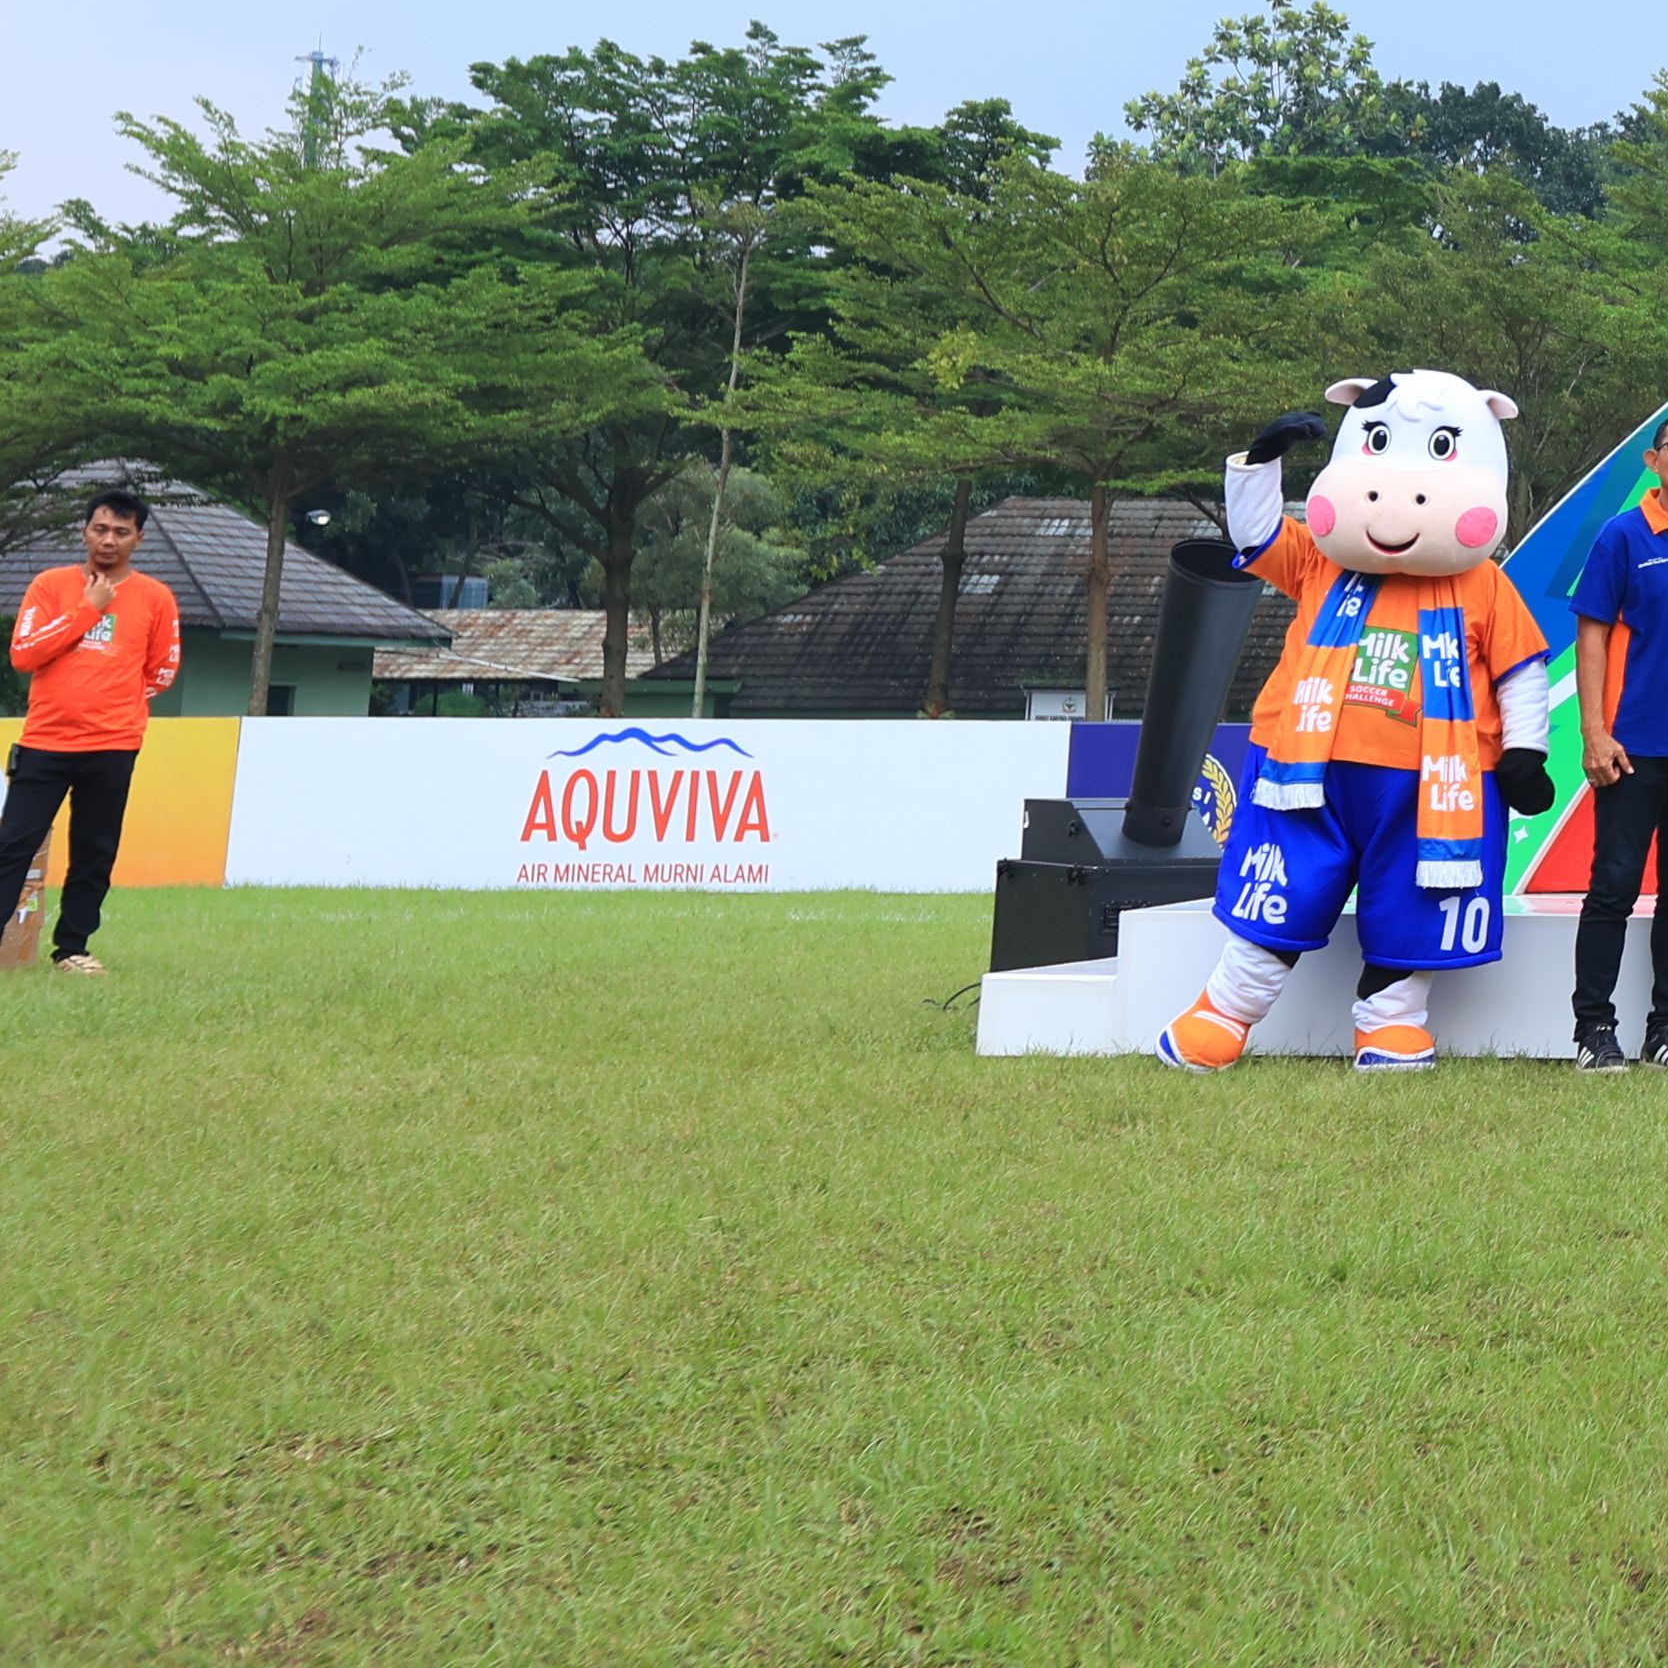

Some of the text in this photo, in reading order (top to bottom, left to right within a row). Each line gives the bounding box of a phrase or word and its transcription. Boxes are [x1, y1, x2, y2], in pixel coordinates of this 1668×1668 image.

[1358, 631, 1410, 663] Milk
[1351, 657, 1408, 689] Life
[1344, 692, 1395, 707] HALLENGE
[1349, 684, 1388, 698] SOCCER
[1421, 754, 1468, 782] Milk
[520, 768, 771, 851] AQUVIVA
[1430, 783, 1475, 812] Life
[517, 863, 769, 883] AIR MINERAL MURNI ALAMI
[1239, 843, 1288, 887] Milk
[1231, 882, 1288, 925] Life
[1438, 895, 1490, 954] 10
